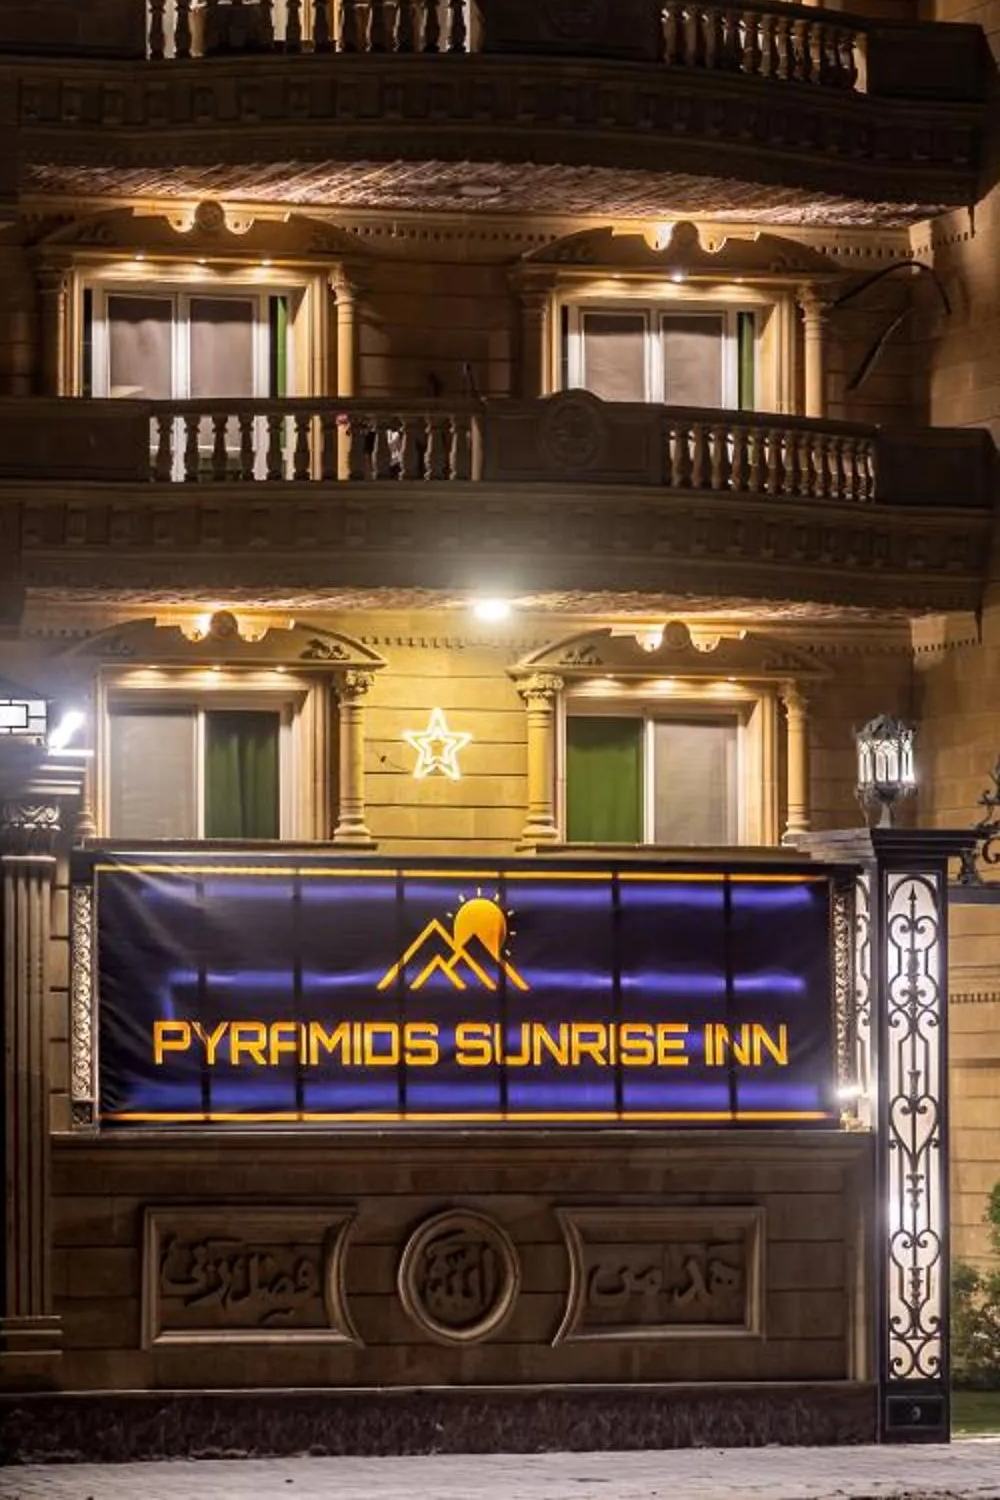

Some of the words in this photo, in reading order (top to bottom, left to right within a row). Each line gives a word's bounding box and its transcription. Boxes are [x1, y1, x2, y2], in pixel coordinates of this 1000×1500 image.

[153, 1020, 440, 1066] PYRAMIDS
[454, 1022, 690, 1066] SUNRISE
[705, 1023, 789, 1066] INN
